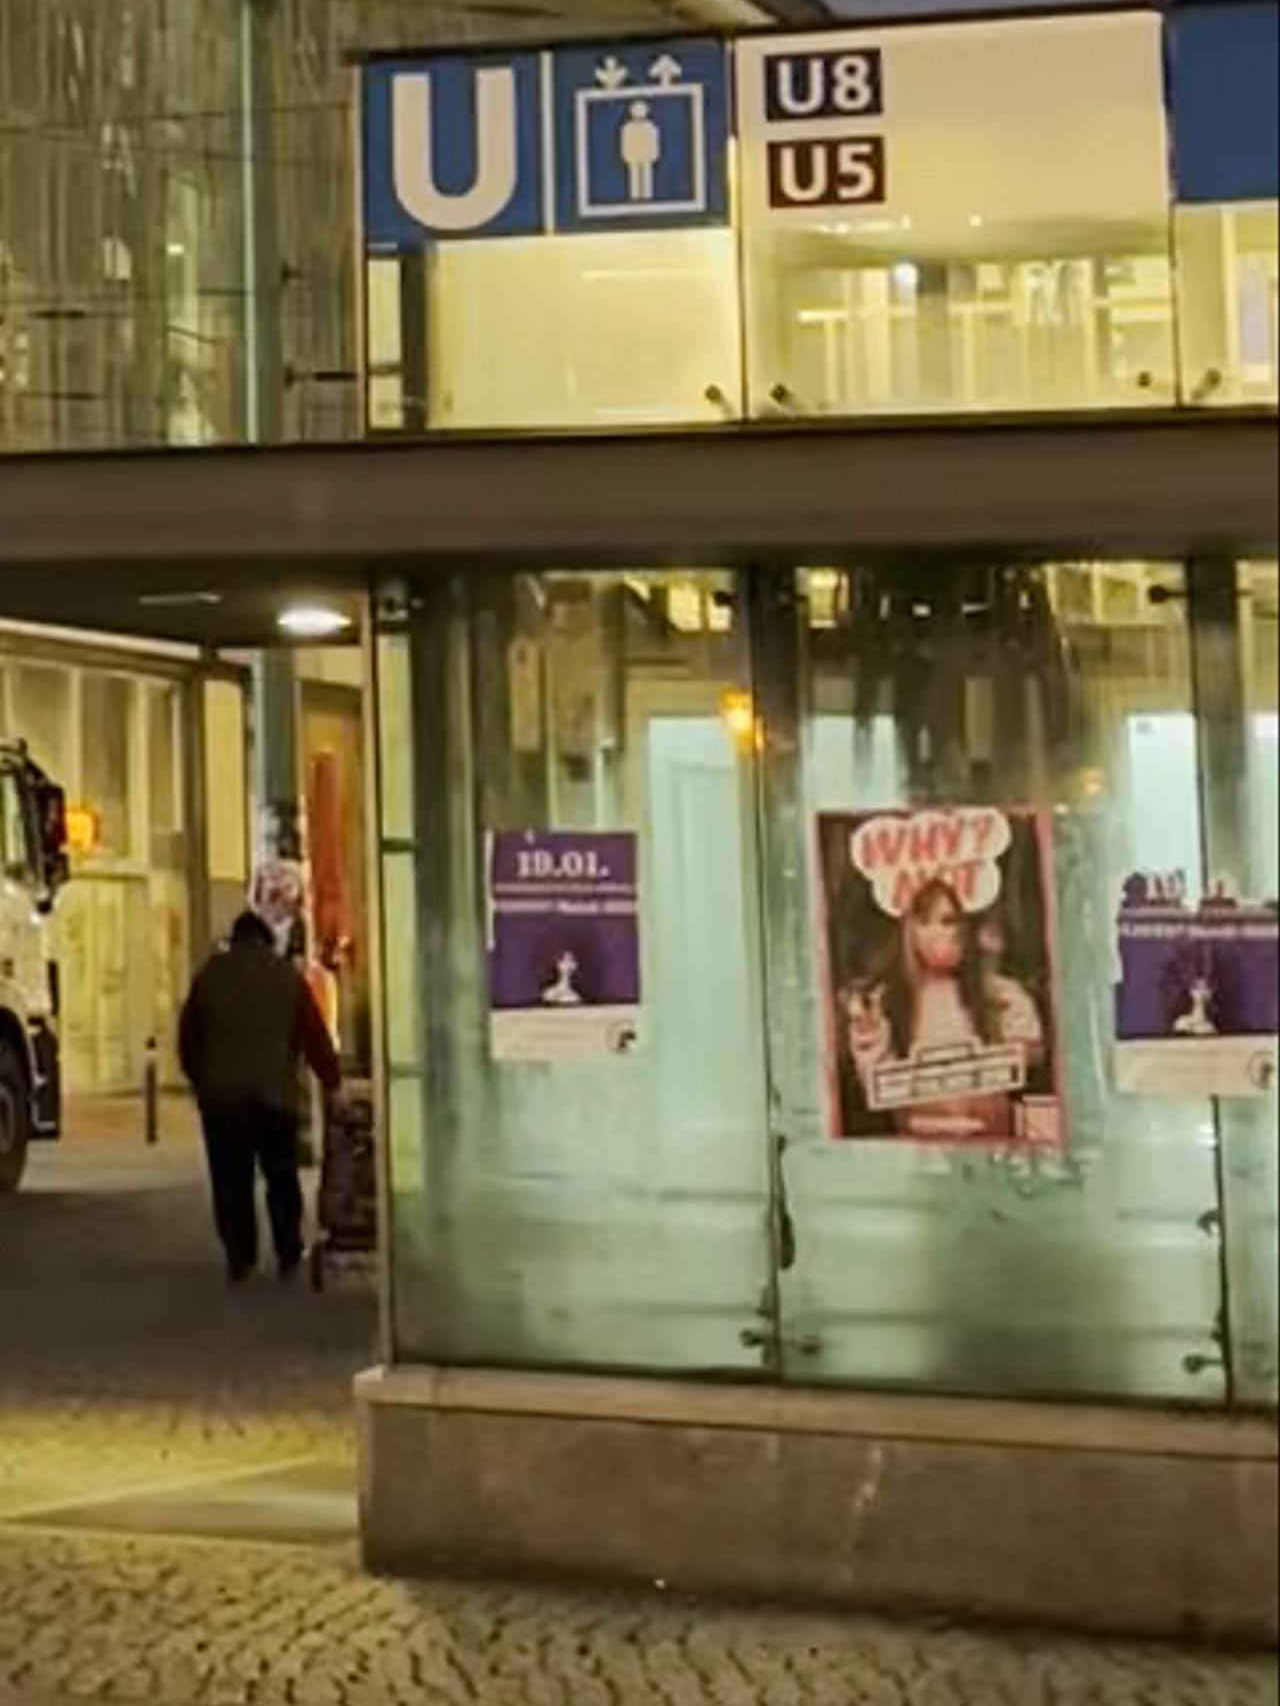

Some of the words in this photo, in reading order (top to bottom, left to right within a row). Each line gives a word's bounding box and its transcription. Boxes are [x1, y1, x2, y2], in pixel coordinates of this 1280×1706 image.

[774, 55, 874, 115] U8
[391, 65, 518, 231] U
[778, 142, 876, 203] U5
[861, 812, 996, 870] WHY?
[892, 862, 980, 912] NT
